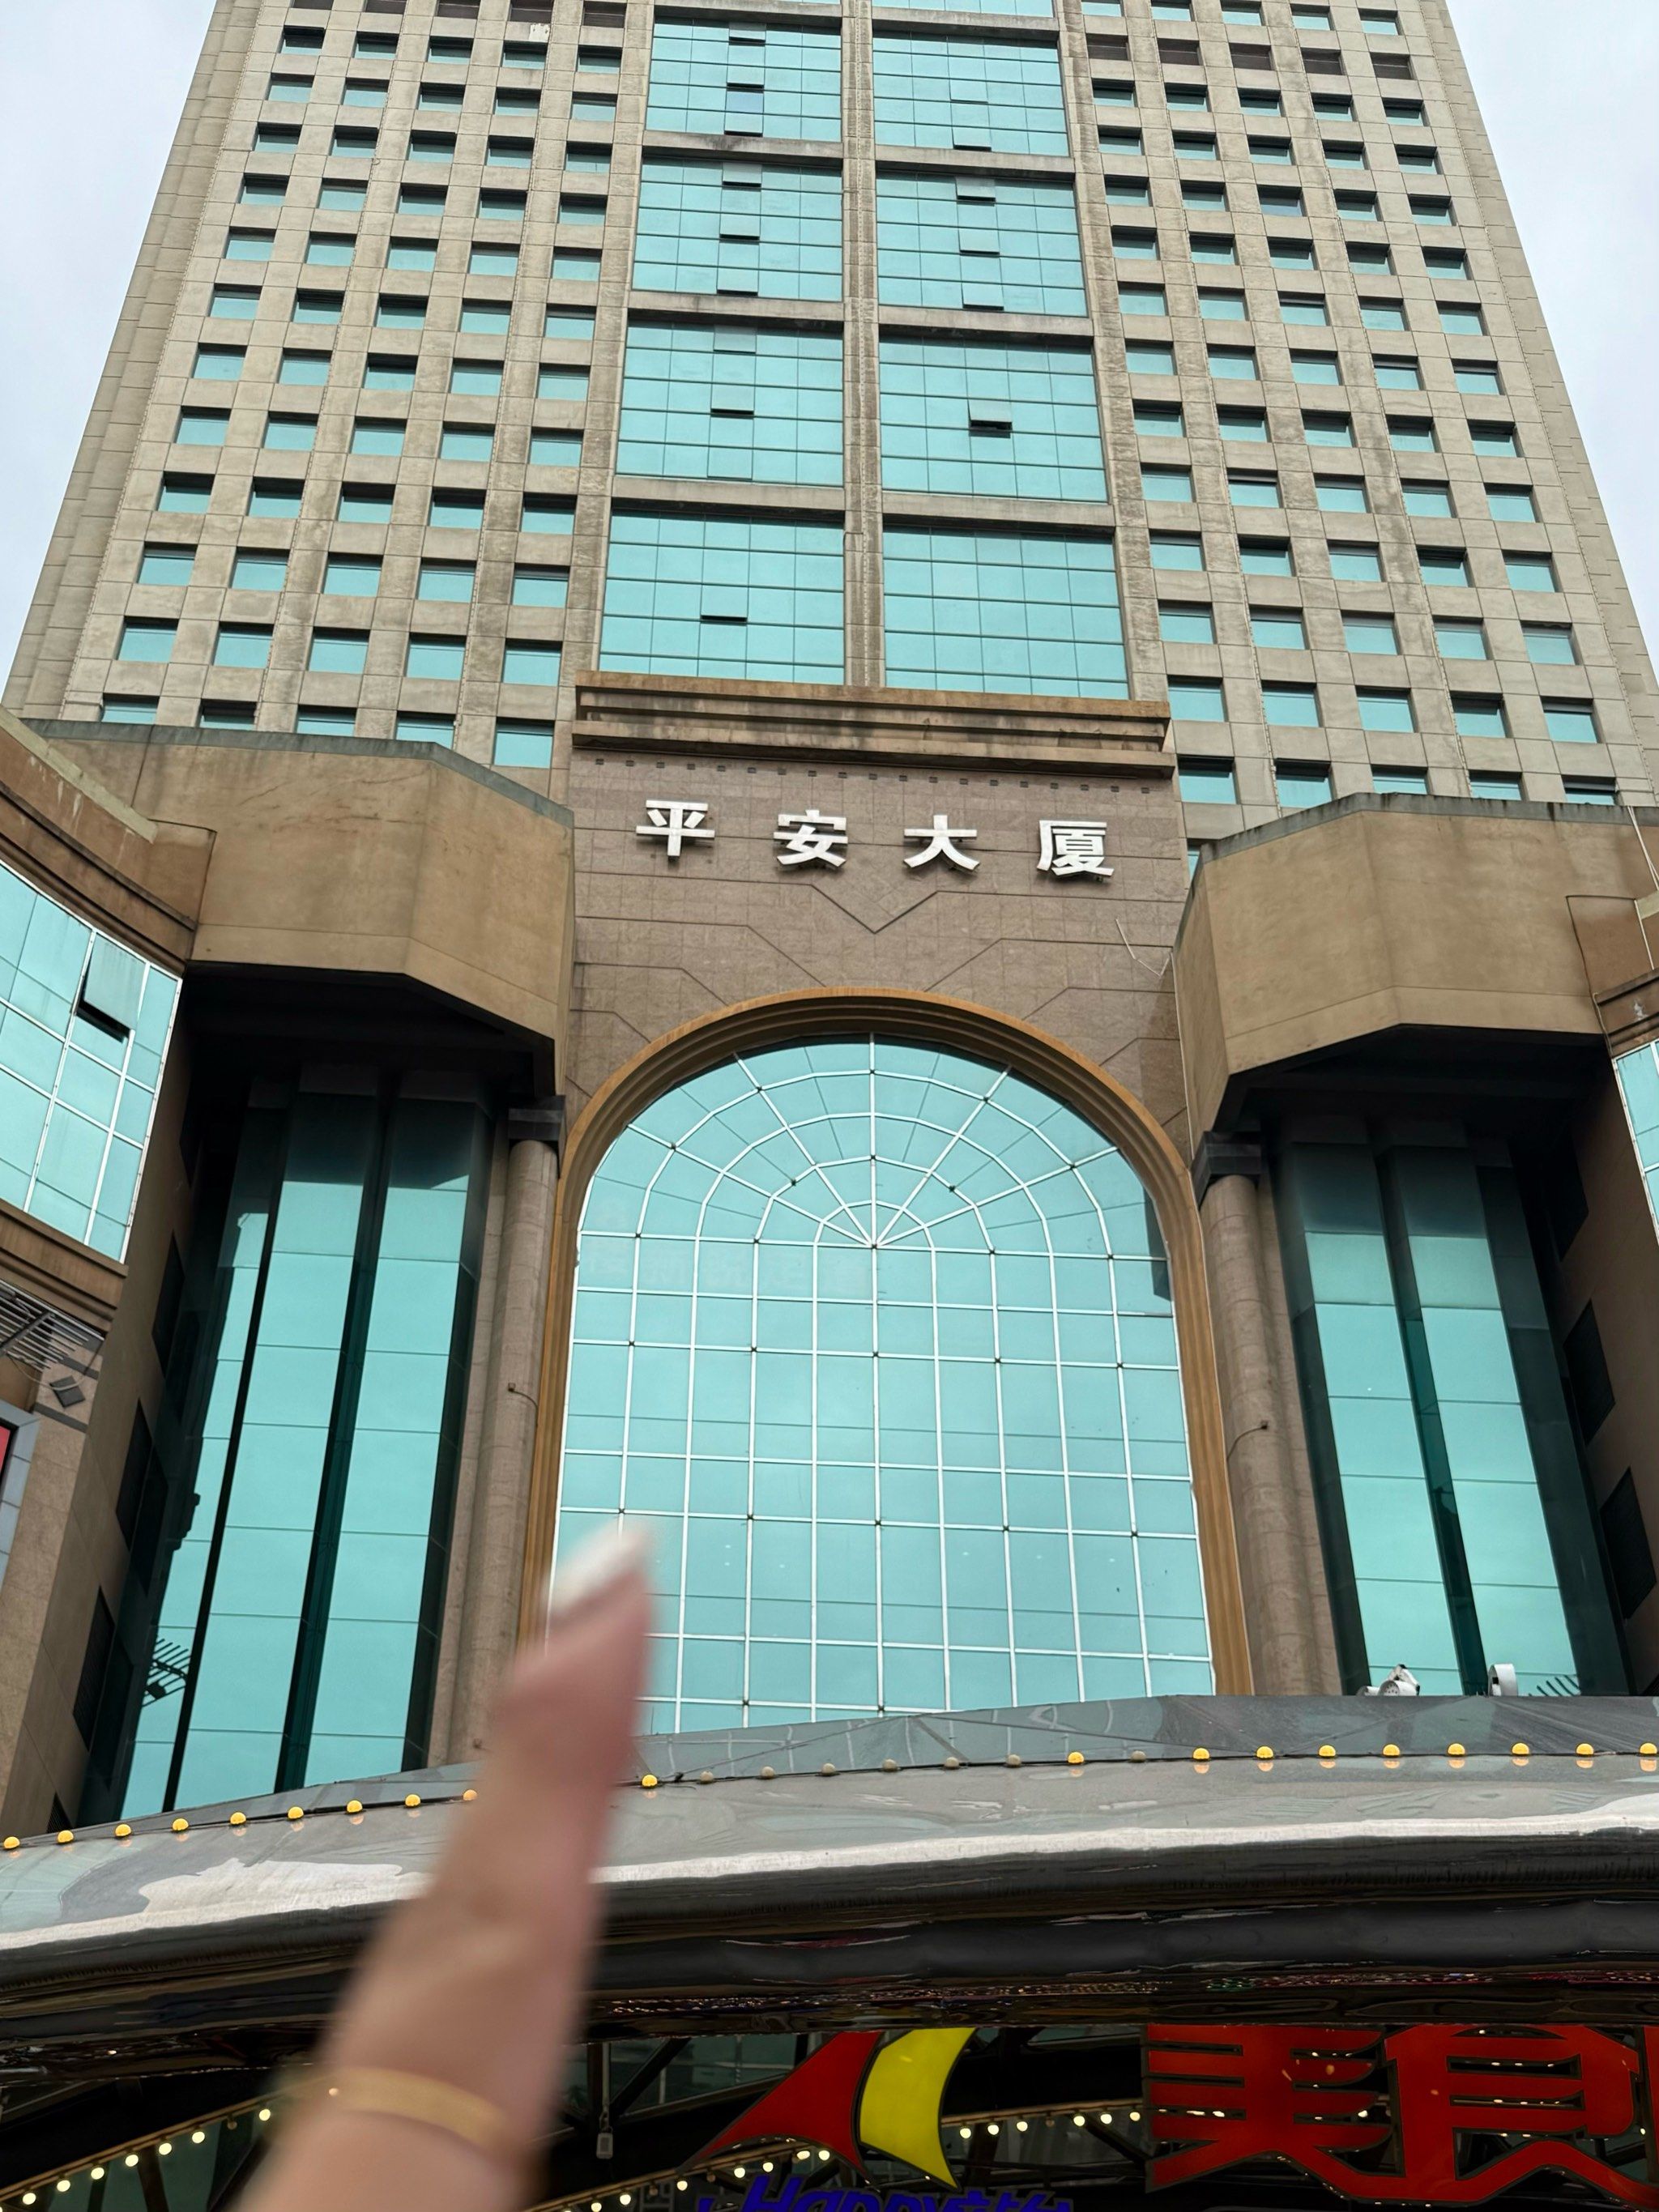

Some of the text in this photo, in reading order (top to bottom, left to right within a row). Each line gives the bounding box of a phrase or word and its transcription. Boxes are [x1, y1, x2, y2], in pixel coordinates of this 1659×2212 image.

[636, 799, 1115, 878] 平安大厦
[1146, 2023, 1659, 2208] 美食
